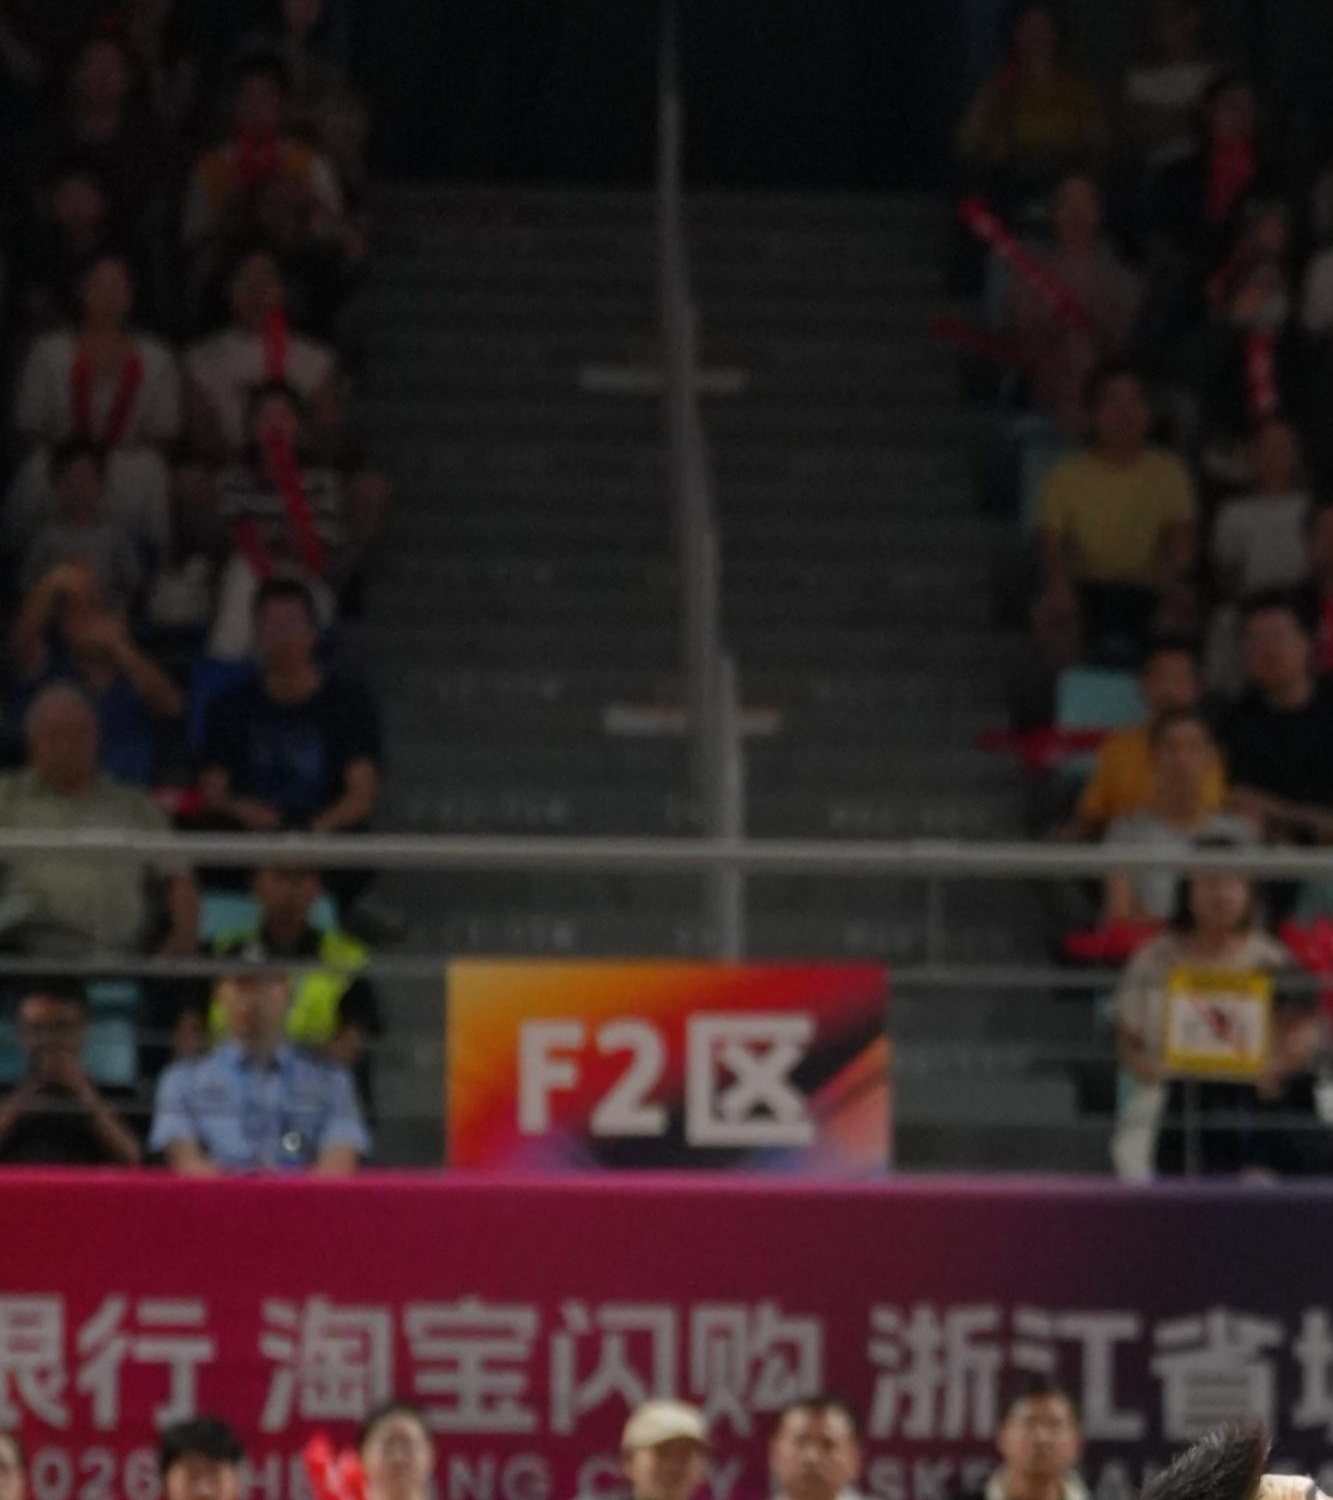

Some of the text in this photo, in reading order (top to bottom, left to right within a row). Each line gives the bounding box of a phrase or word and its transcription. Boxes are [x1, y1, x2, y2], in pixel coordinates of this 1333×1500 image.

[517, 1012, 815, 1148] F2区
[258, 1294, 824, 1436] 淘宝闪购
